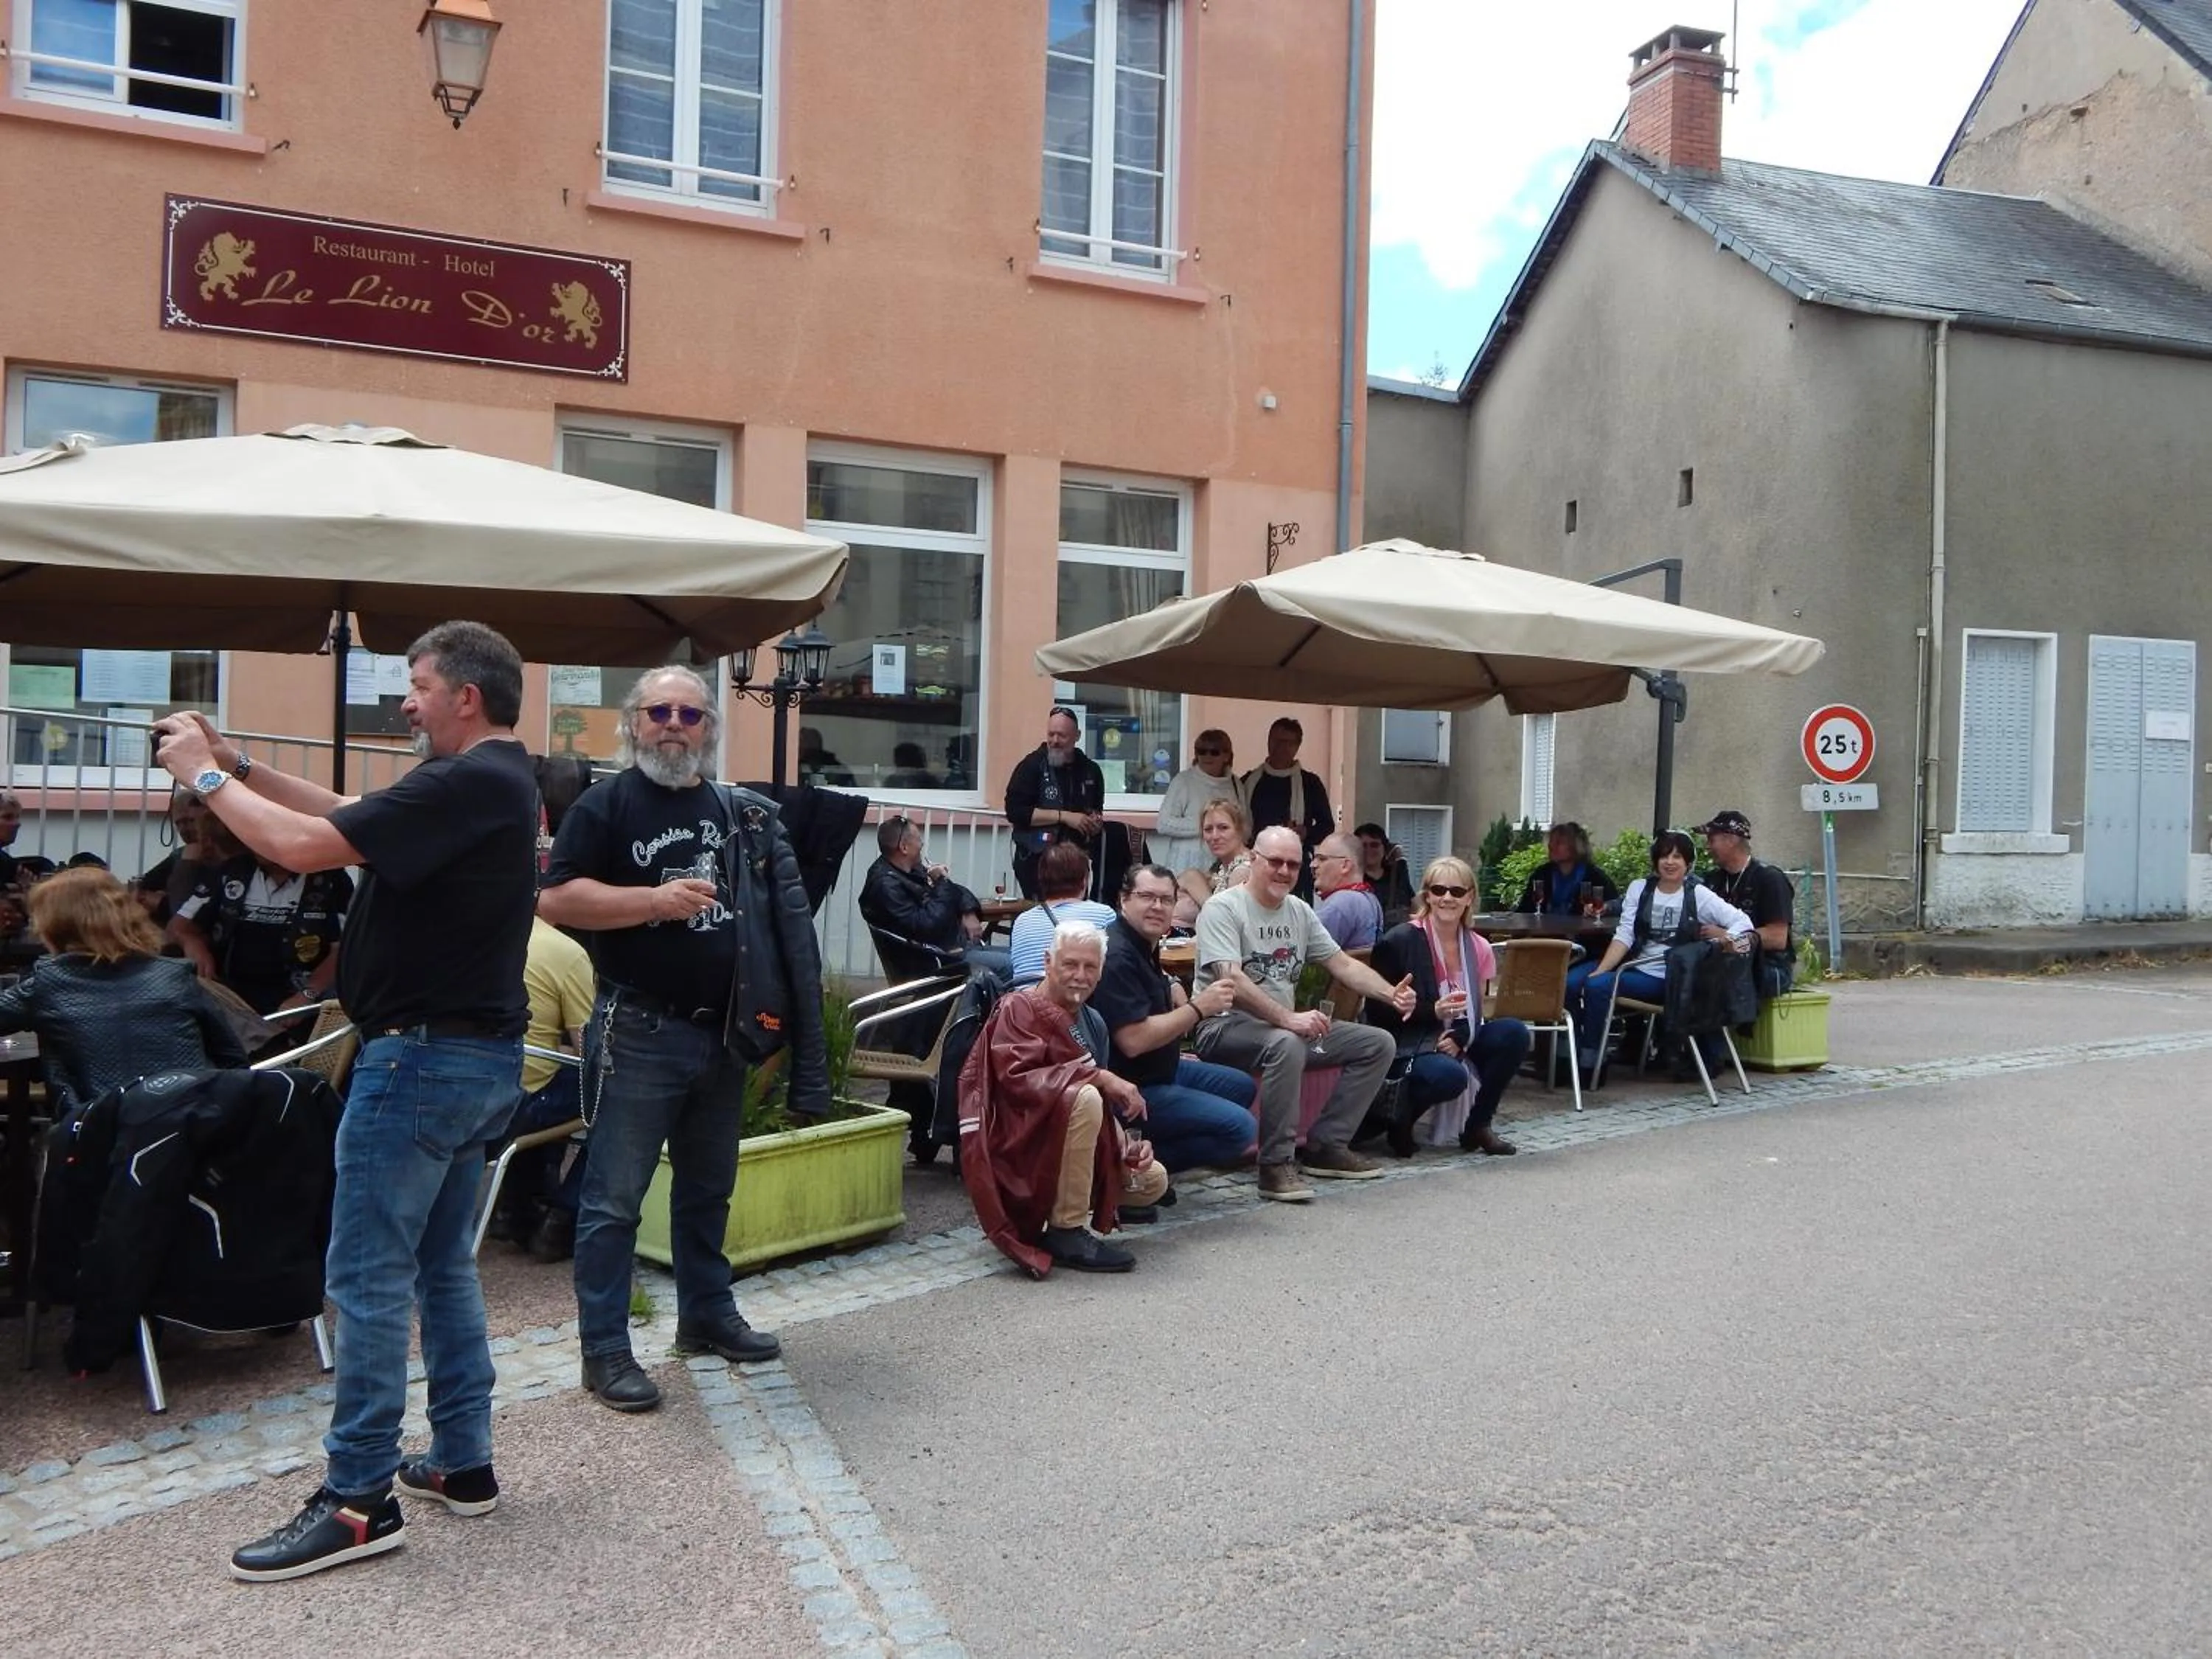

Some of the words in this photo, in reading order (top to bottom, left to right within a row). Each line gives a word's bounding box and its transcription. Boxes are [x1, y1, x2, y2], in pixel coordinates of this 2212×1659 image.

[313, 235, 416, 266] Restaurant
[445, 254, 495, 278] Hotel
[240, 270, 314, 305] Le
[327, 274, 433, 313] Lion
[1259, 926, 1291, 939] 1968
